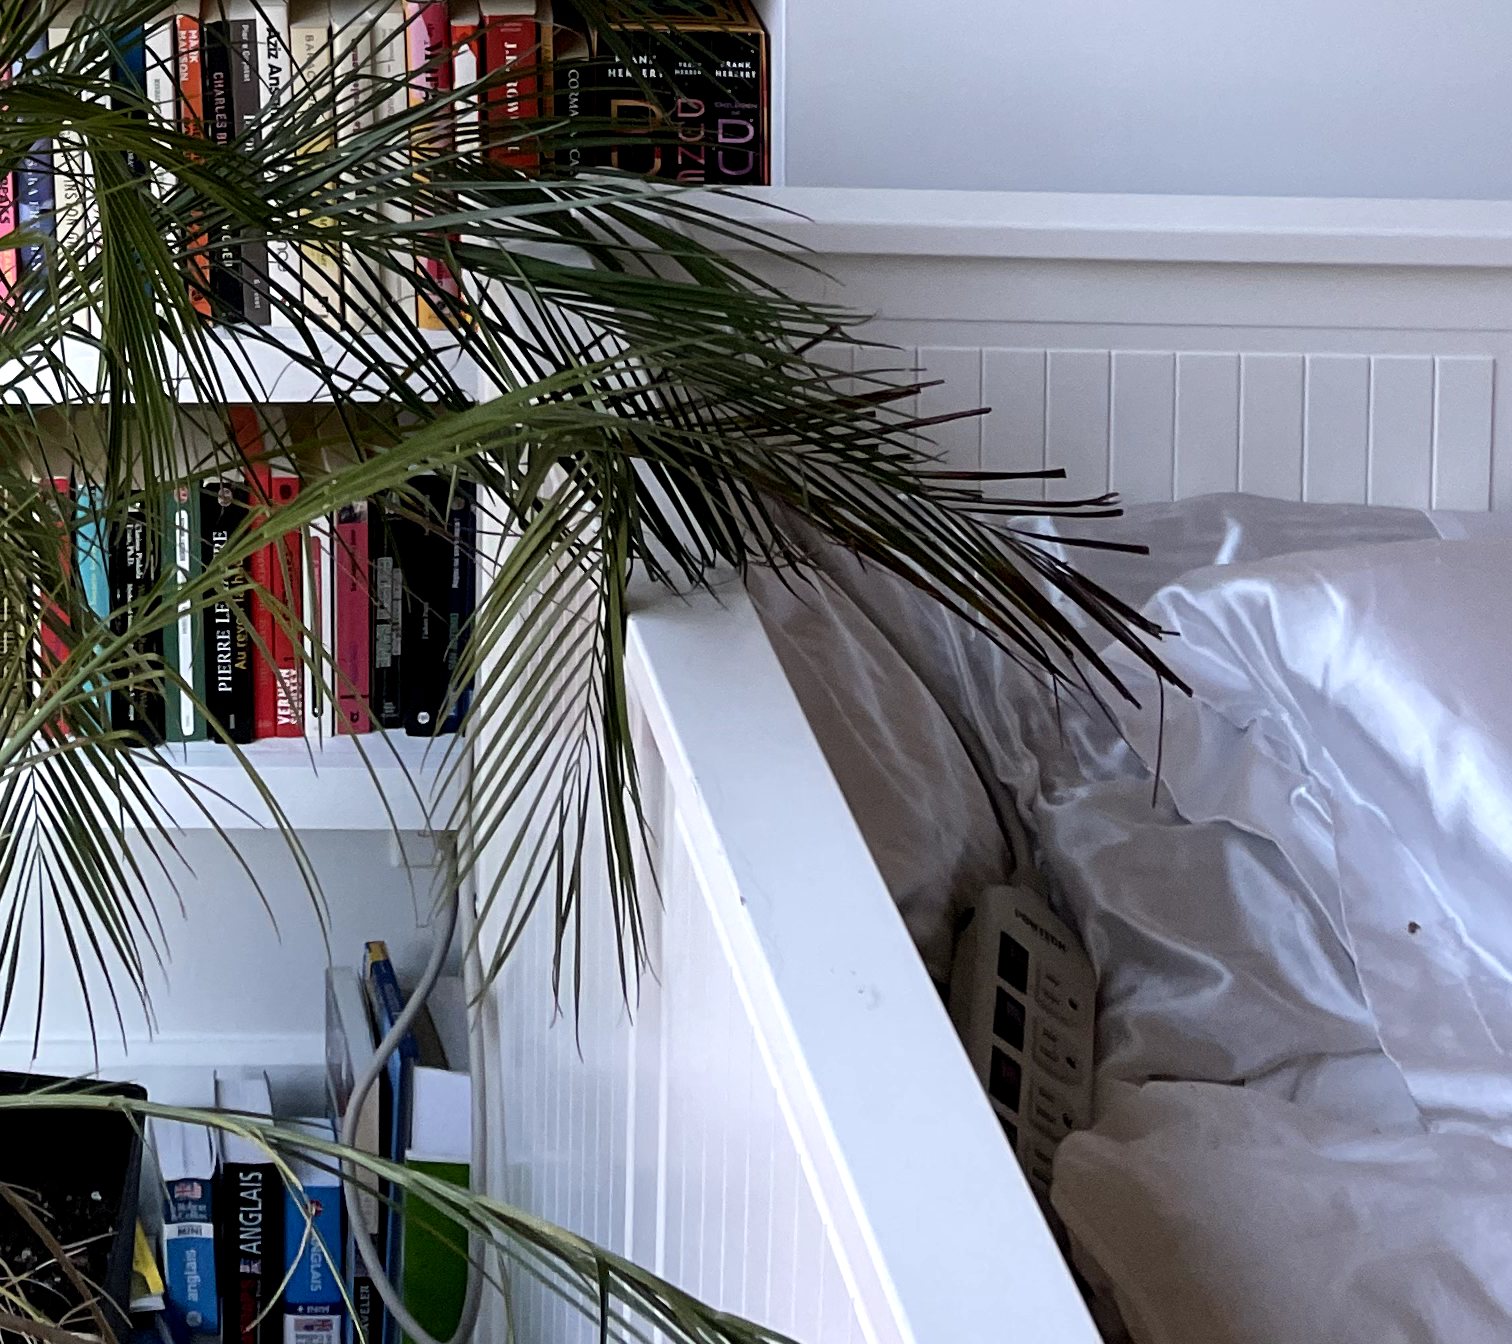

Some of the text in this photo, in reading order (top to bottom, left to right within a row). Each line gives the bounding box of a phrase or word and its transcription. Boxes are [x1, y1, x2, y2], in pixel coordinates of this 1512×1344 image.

[212, 72, 227, 128] CHARLES
[216, 629, 234, 692] PIERRE
[239, 1172, 262, 1254] ANGLAIS
[184, 1249, 201, 1302] anglais
